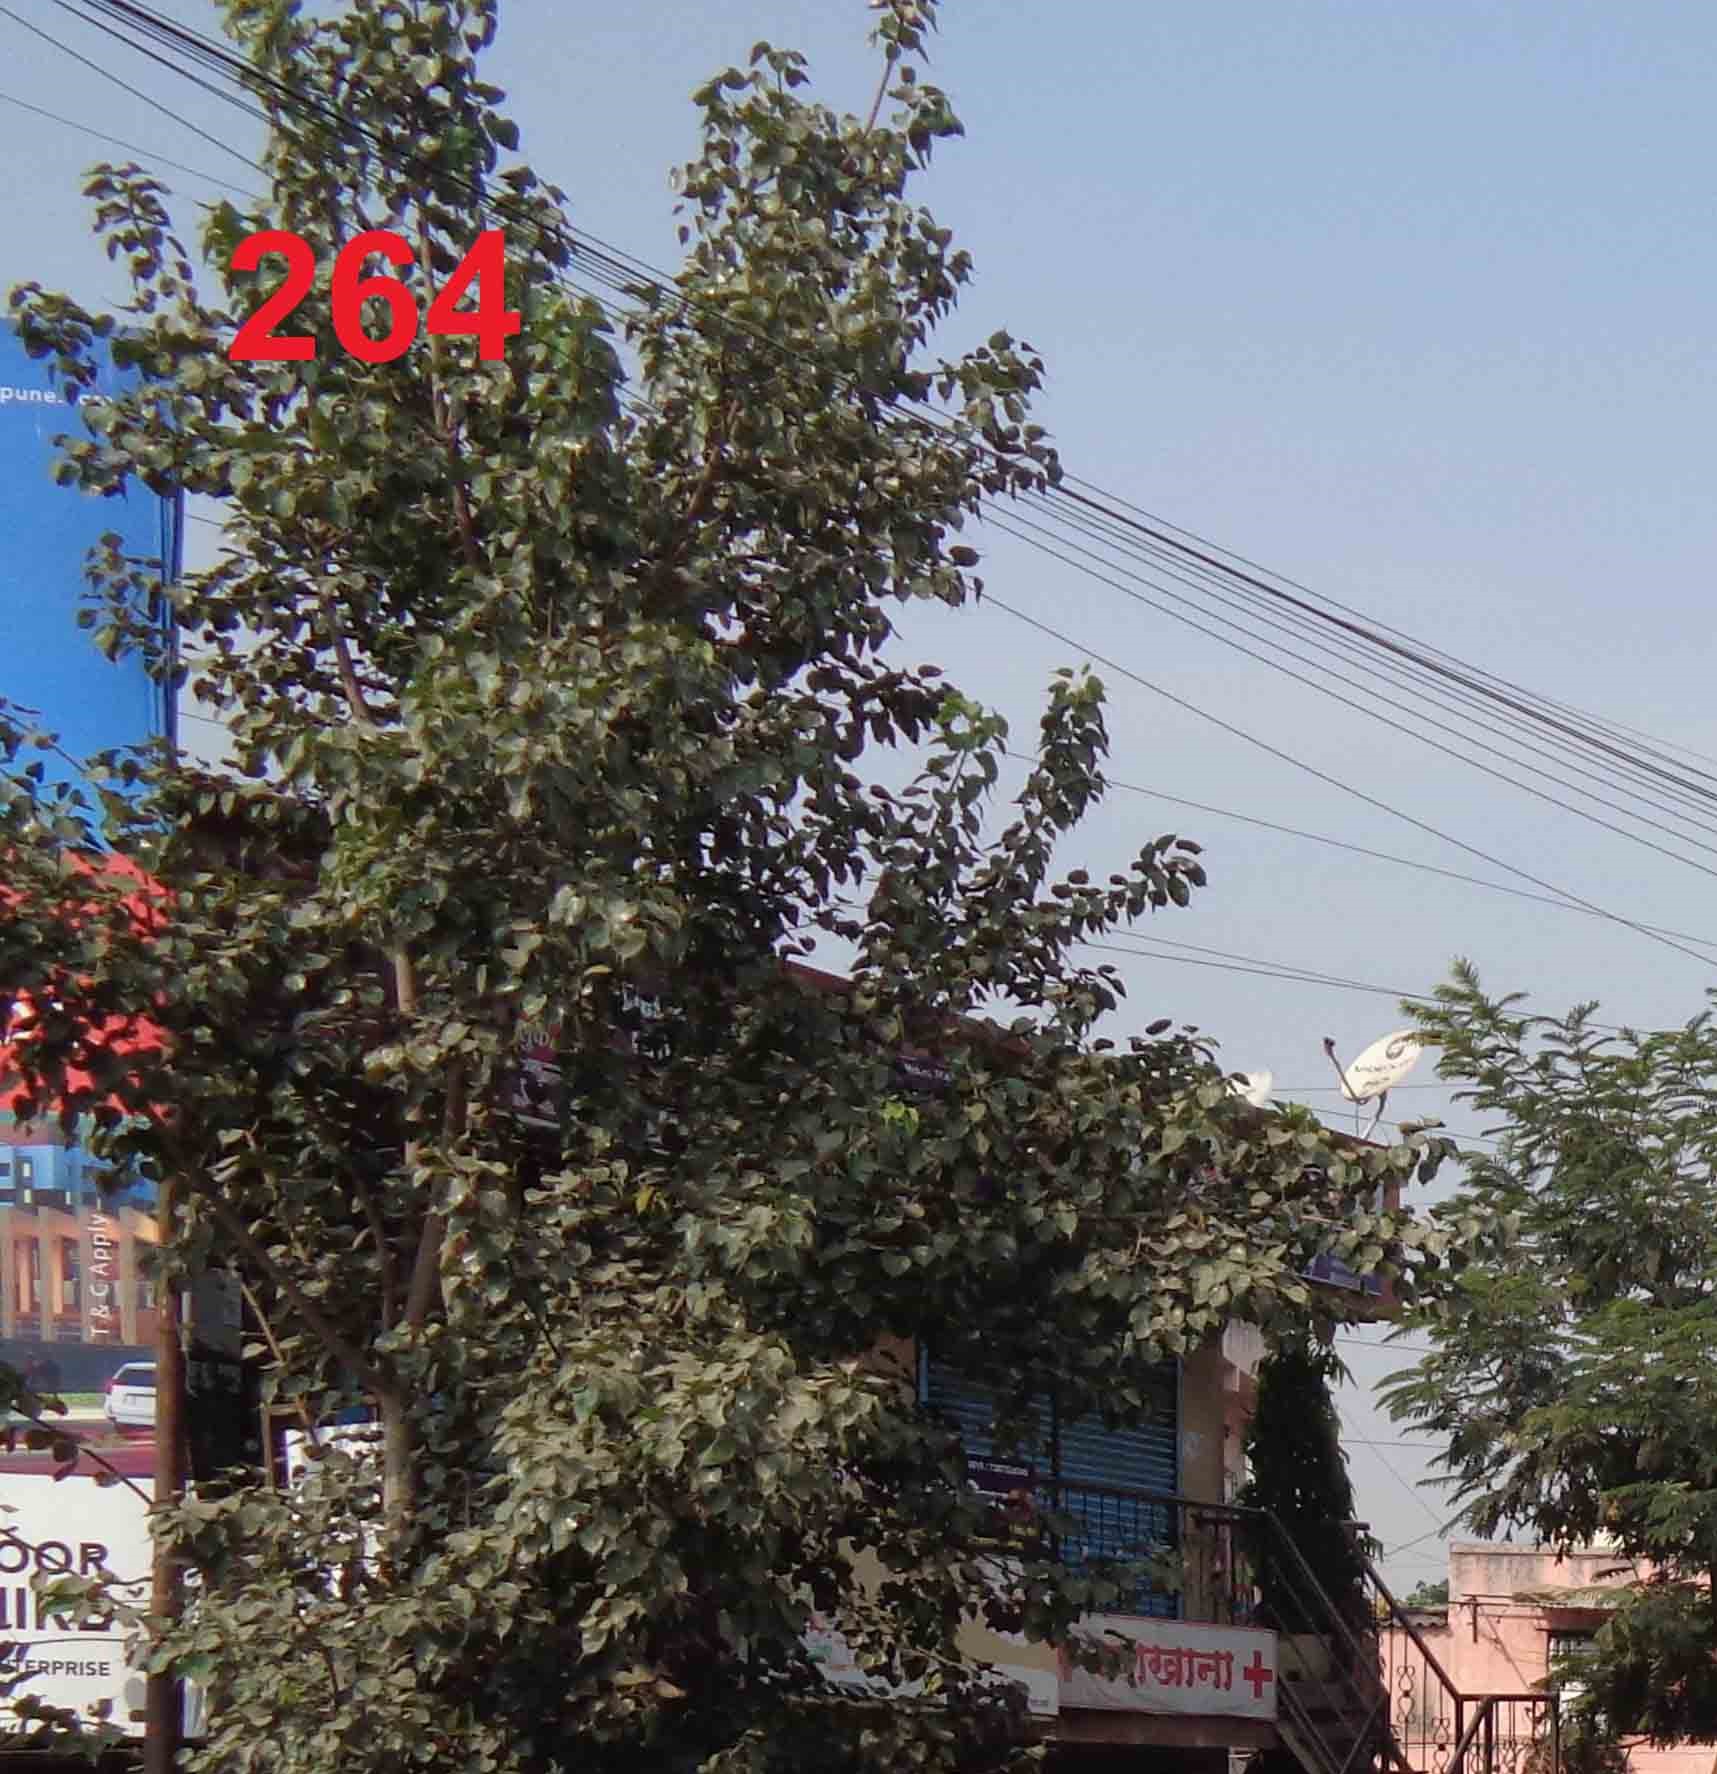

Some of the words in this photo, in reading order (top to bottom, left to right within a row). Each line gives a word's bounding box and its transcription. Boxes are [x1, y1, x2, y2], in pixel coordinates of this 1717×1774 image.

[88, 1213, 113, 1276] Apply
[90, 1283, 109, 1297] C
[90, 1305, 113, 1321] &
[90, 1328, 110, 1337] T
